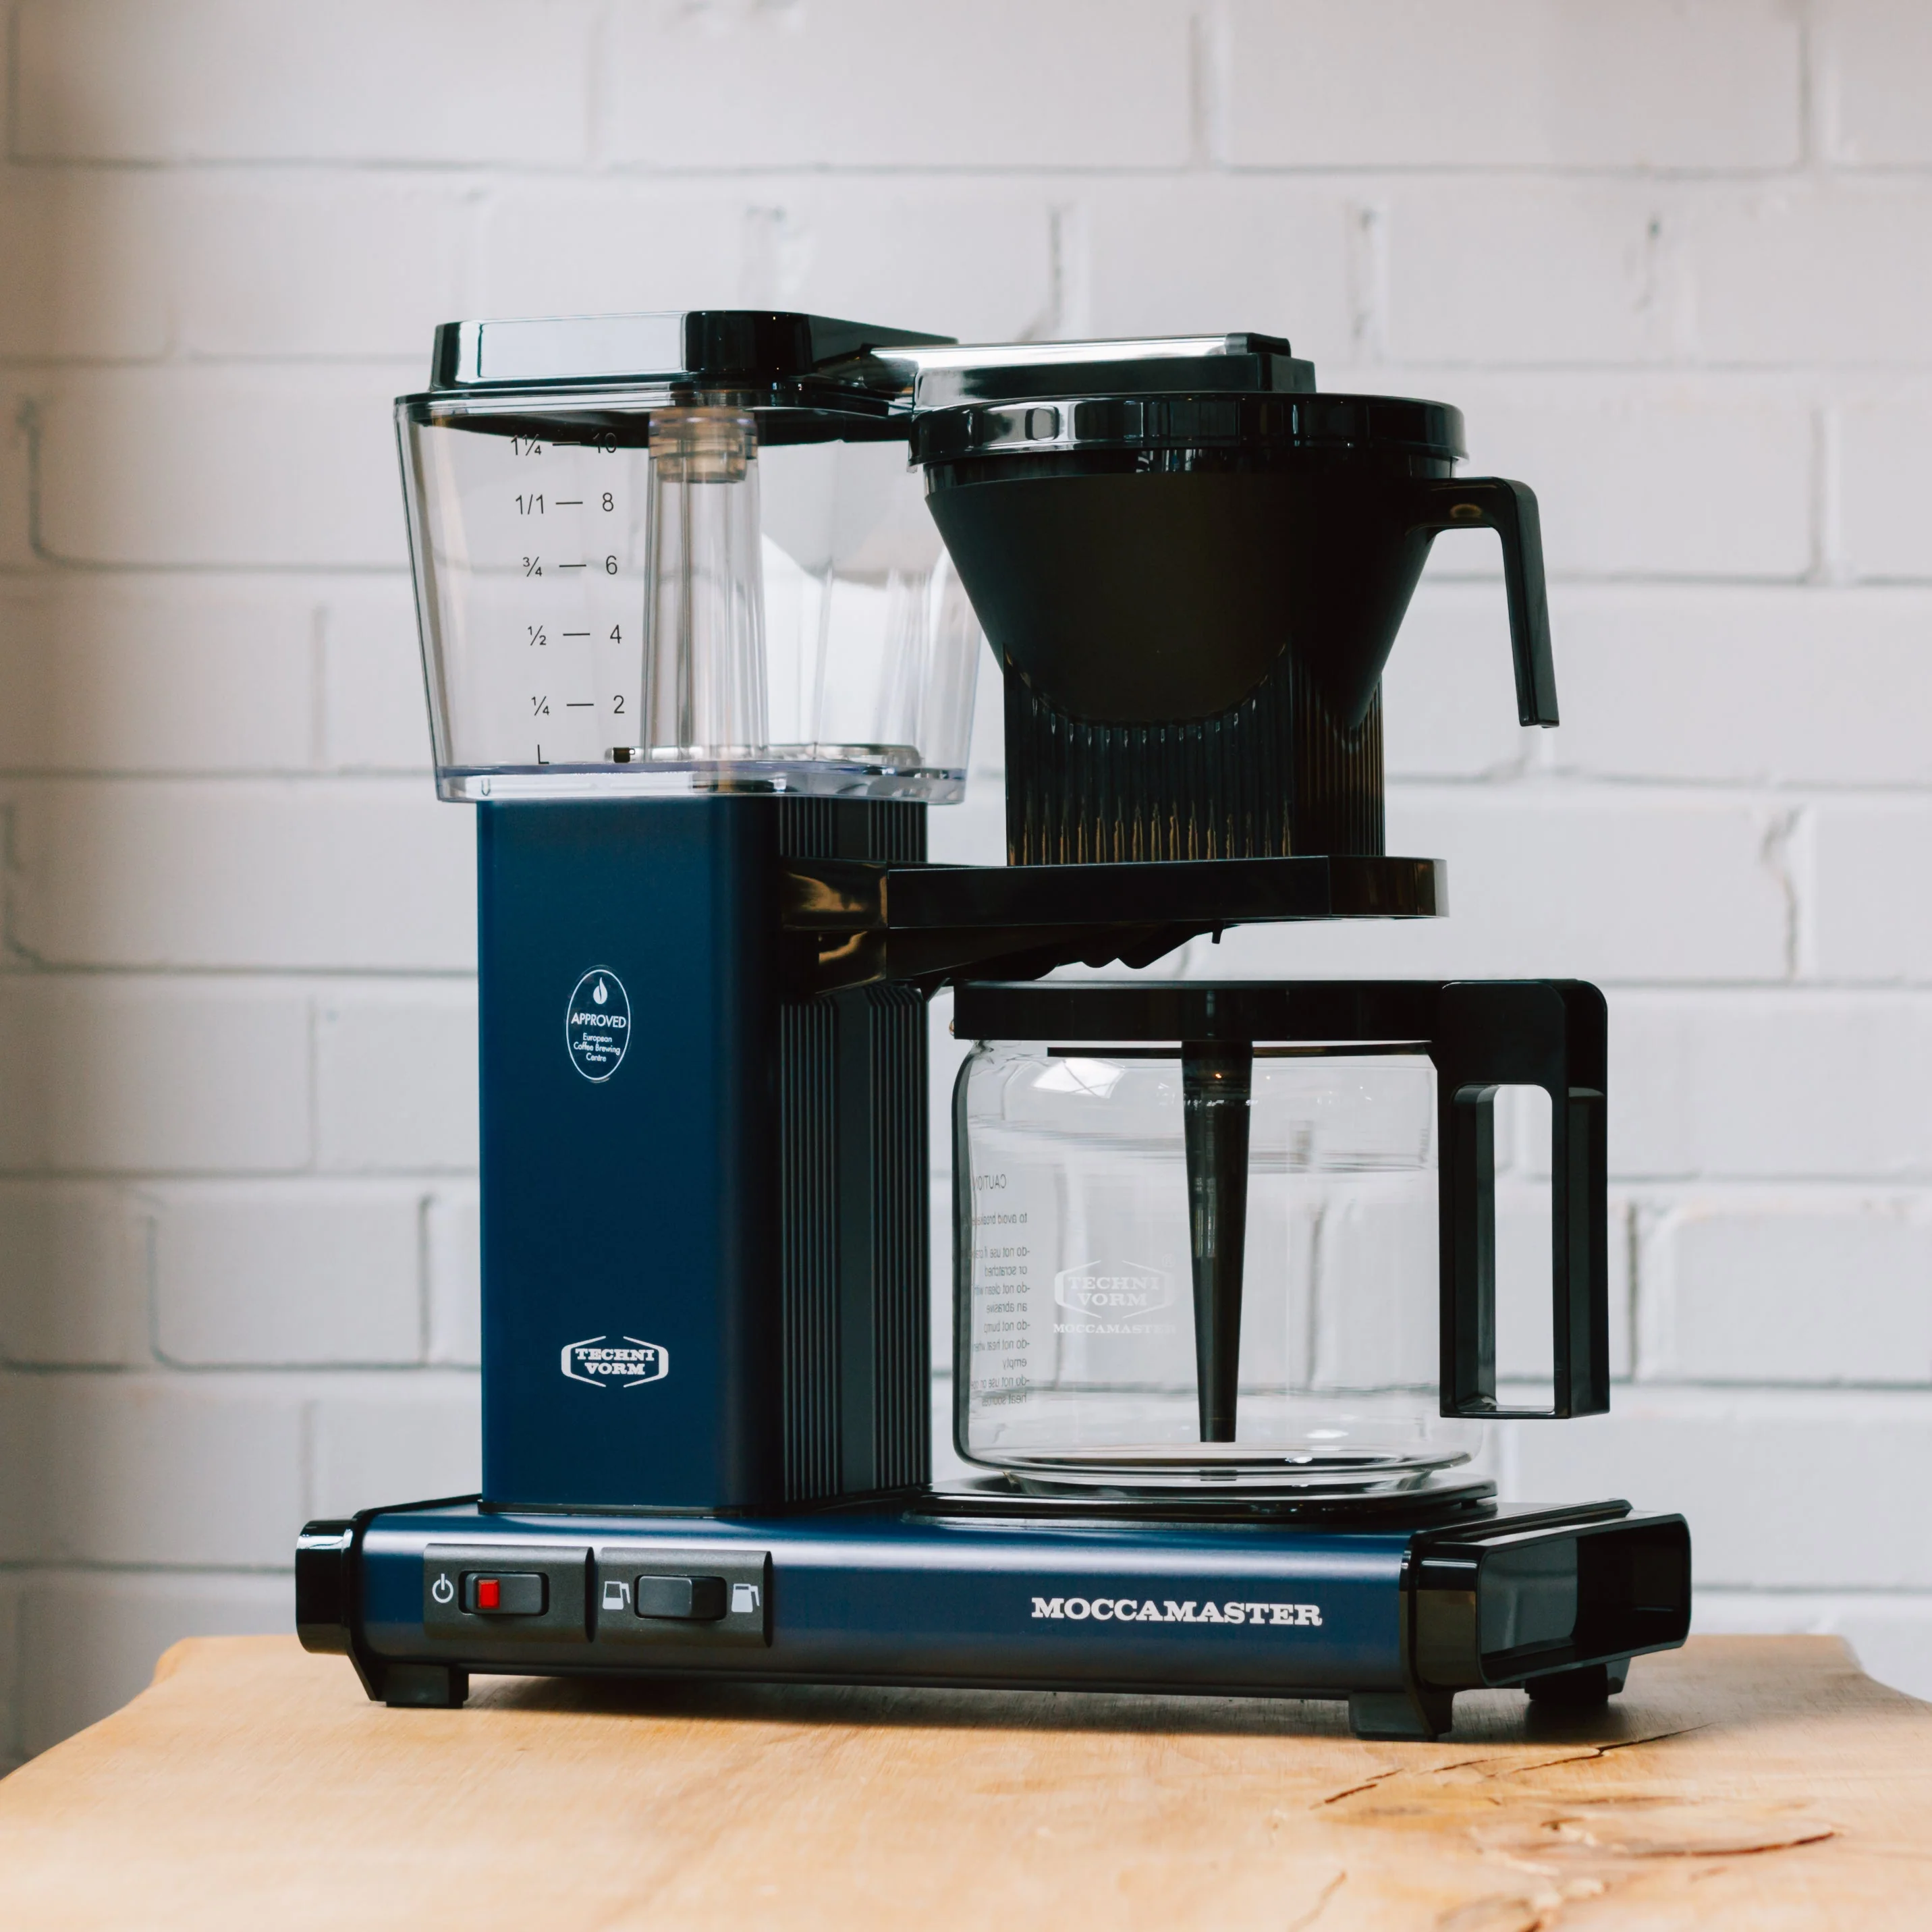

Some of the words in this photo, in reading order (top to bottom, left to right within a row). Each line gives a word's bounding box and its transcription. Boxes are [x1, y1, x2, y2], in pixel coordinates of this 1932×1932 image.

[593, 433, 617, 453] 10
[516, 494, 543, 515] 1/1
[603, 493, 613, 512] 8
[606, 555, 617, 575] 6
[610, 624, 622, 644] 4
[613, 695, 625, 714] 2
[537, 744, 549, 765] L
[571, 1012, 626, 1028] APPROVED
[582, 1032, 613, 1043] European
[573, 1041, 594, 1052] Coffee
[595, 1043, 621, 1056] Brewing
[586, 1053, 607, 1062] Centre
[1068, 1277, 1161, 1290] TECHNI
[1077, 1293, 1148, 1306] VORM
[1053, 1323, 1176, 1334] MOCCAMASTER
[575, 1348, 655, 1361] TECHNI
[584, 1362, 645, 1375] VORM
[1031, 1597, 1323, 1626] MOCCAMASTER
